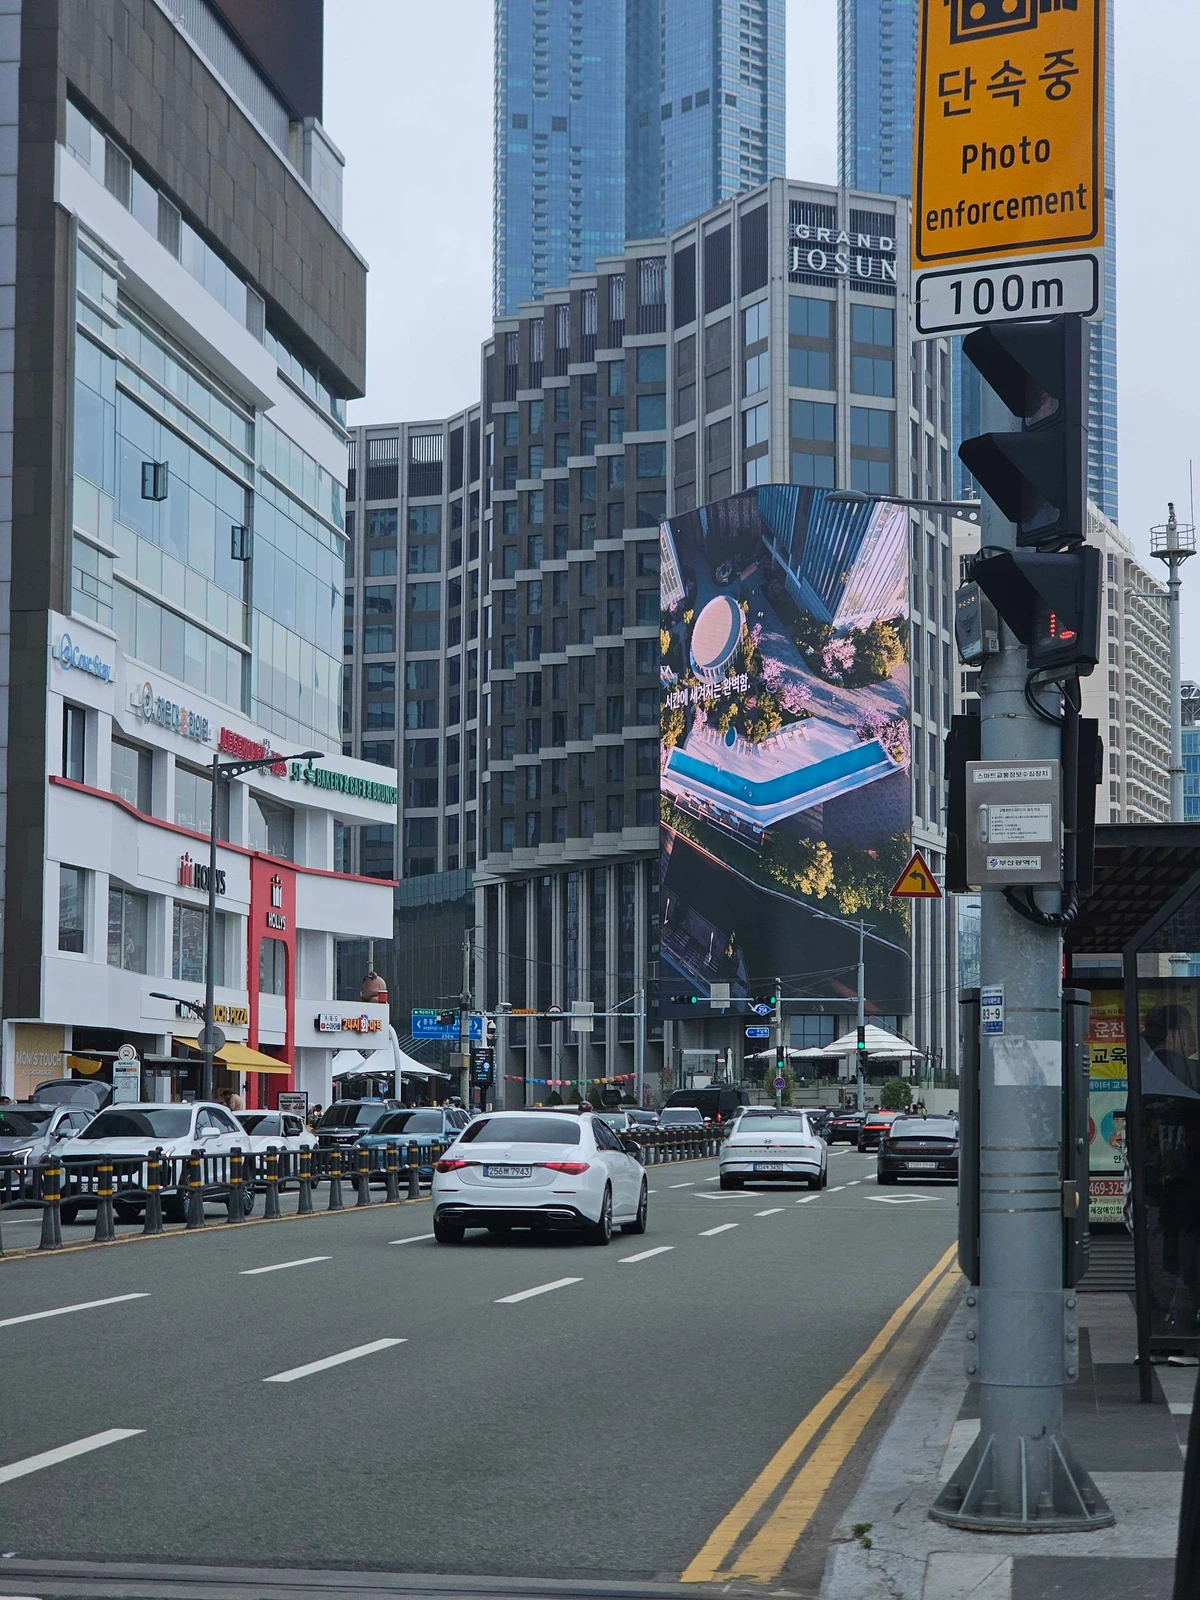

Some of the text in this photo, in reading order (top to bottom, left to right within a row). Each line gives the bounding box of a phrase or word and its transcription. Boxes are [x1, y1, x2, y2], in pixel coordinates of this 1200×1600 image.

[961, 135, 1051, 174] Photo
[926, 183, 1088, 232] enforcement
[795, 224, 894, 252] GRAND
[791, 245, 898, 282] JOSUN
[949, 273, 1064, 316] 100m
[664, 688, 689, 711] 시간에
[723, 672, 751, 696] 완벽함.
[315, 767, 345, 793] BAKERY
[999, 858, 1038, 867] 부산광역시
[267, 911, 286, 930] HOLLYS
[1095, 1021, 1125, 1038] 운전
[16, 1050, 62, 1067] MOM'S TOUCH
[1091, 1047, 1128, 1065] 교육
[511, 1168, 530, 1176] 7943
